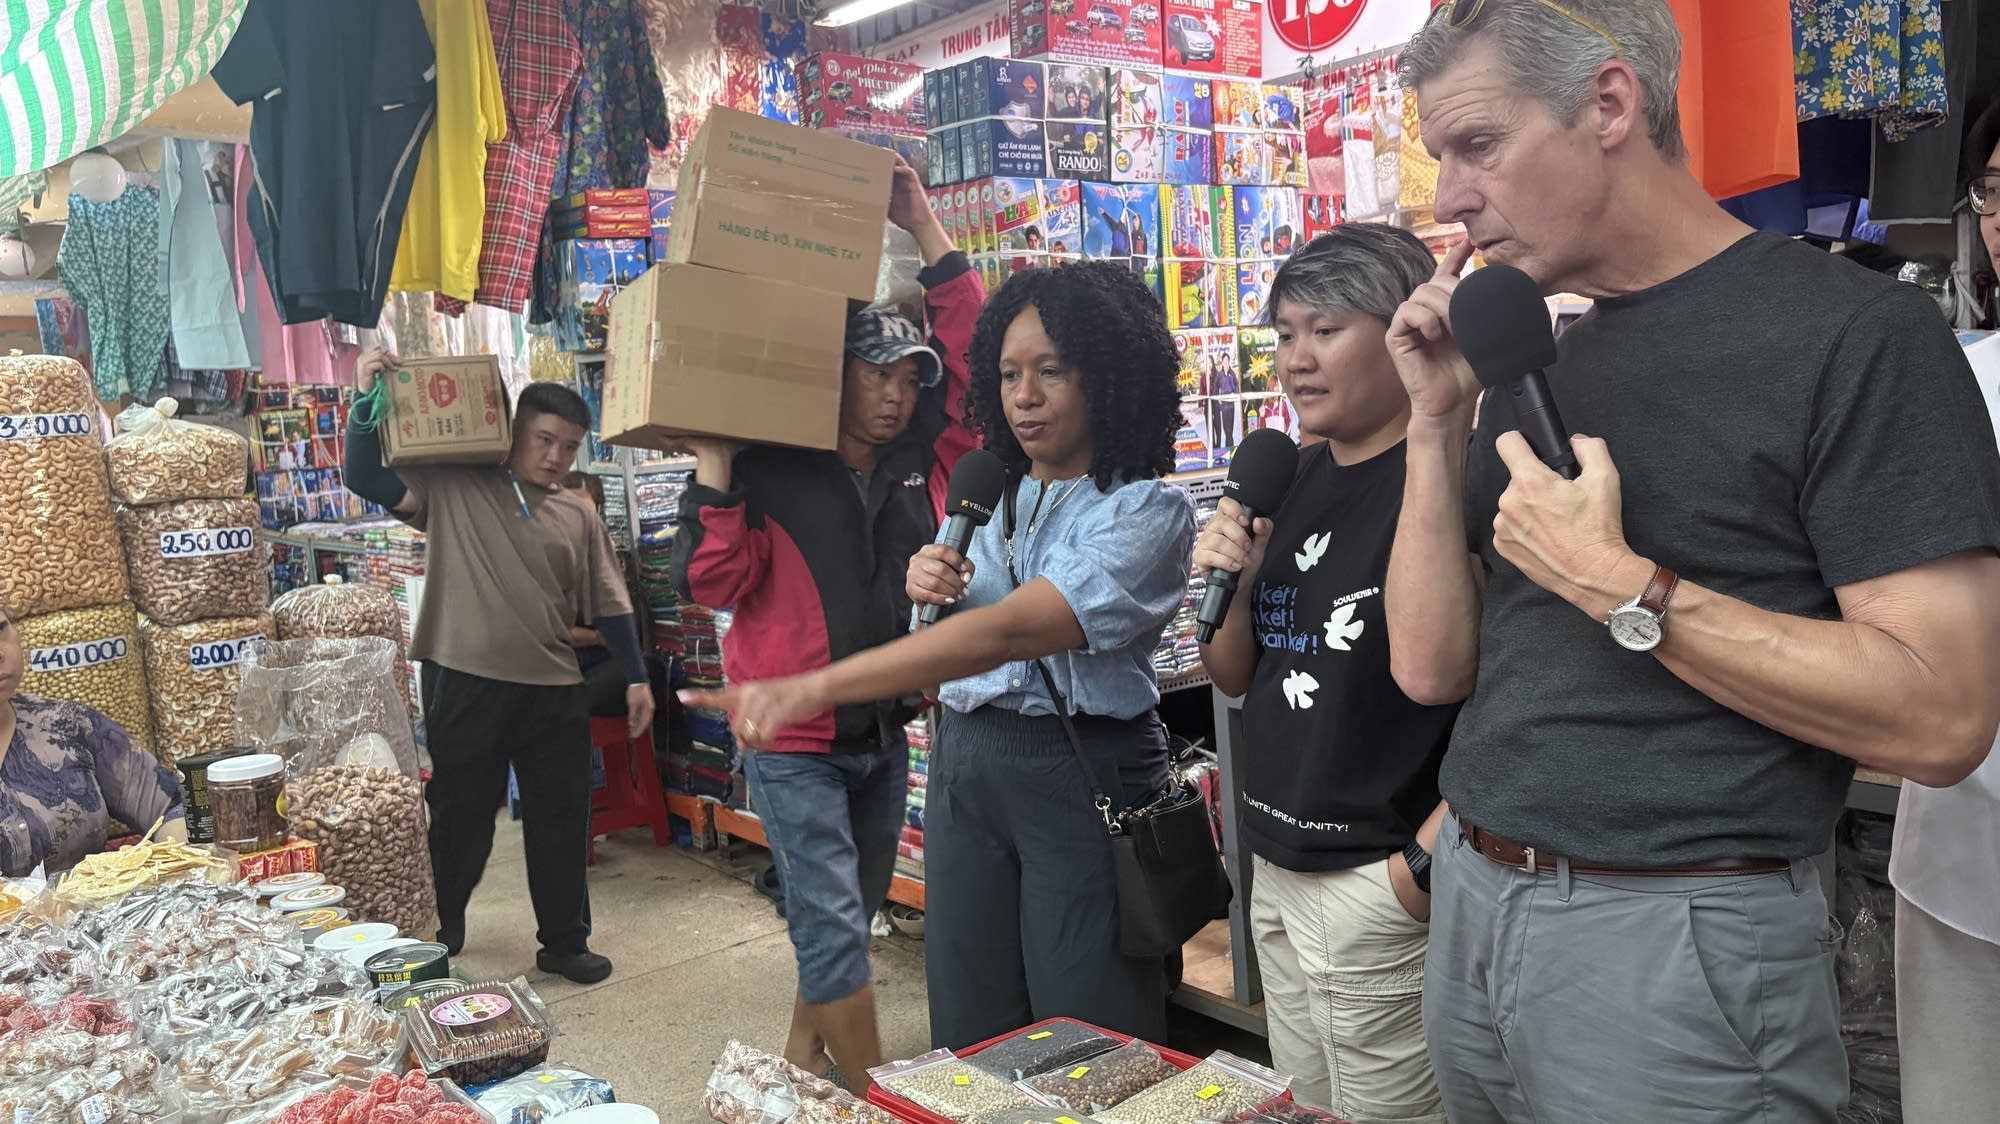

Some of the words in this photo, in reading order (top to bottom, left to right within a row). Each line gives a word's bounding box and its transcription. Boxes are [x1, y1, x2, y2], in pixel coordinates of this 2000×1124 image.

[940, 24, 981, 59] TRUNG
[1059, 155, 1099, 170] RANDO
[718, 219, 751, 238] HÀNG
[1239, 224, 1256, 285] LION
[32, 647, 80, 669] 440
[1271, 808, 1297, 826] GREAT
[1298, 820, 1349, 832] UNITY!
